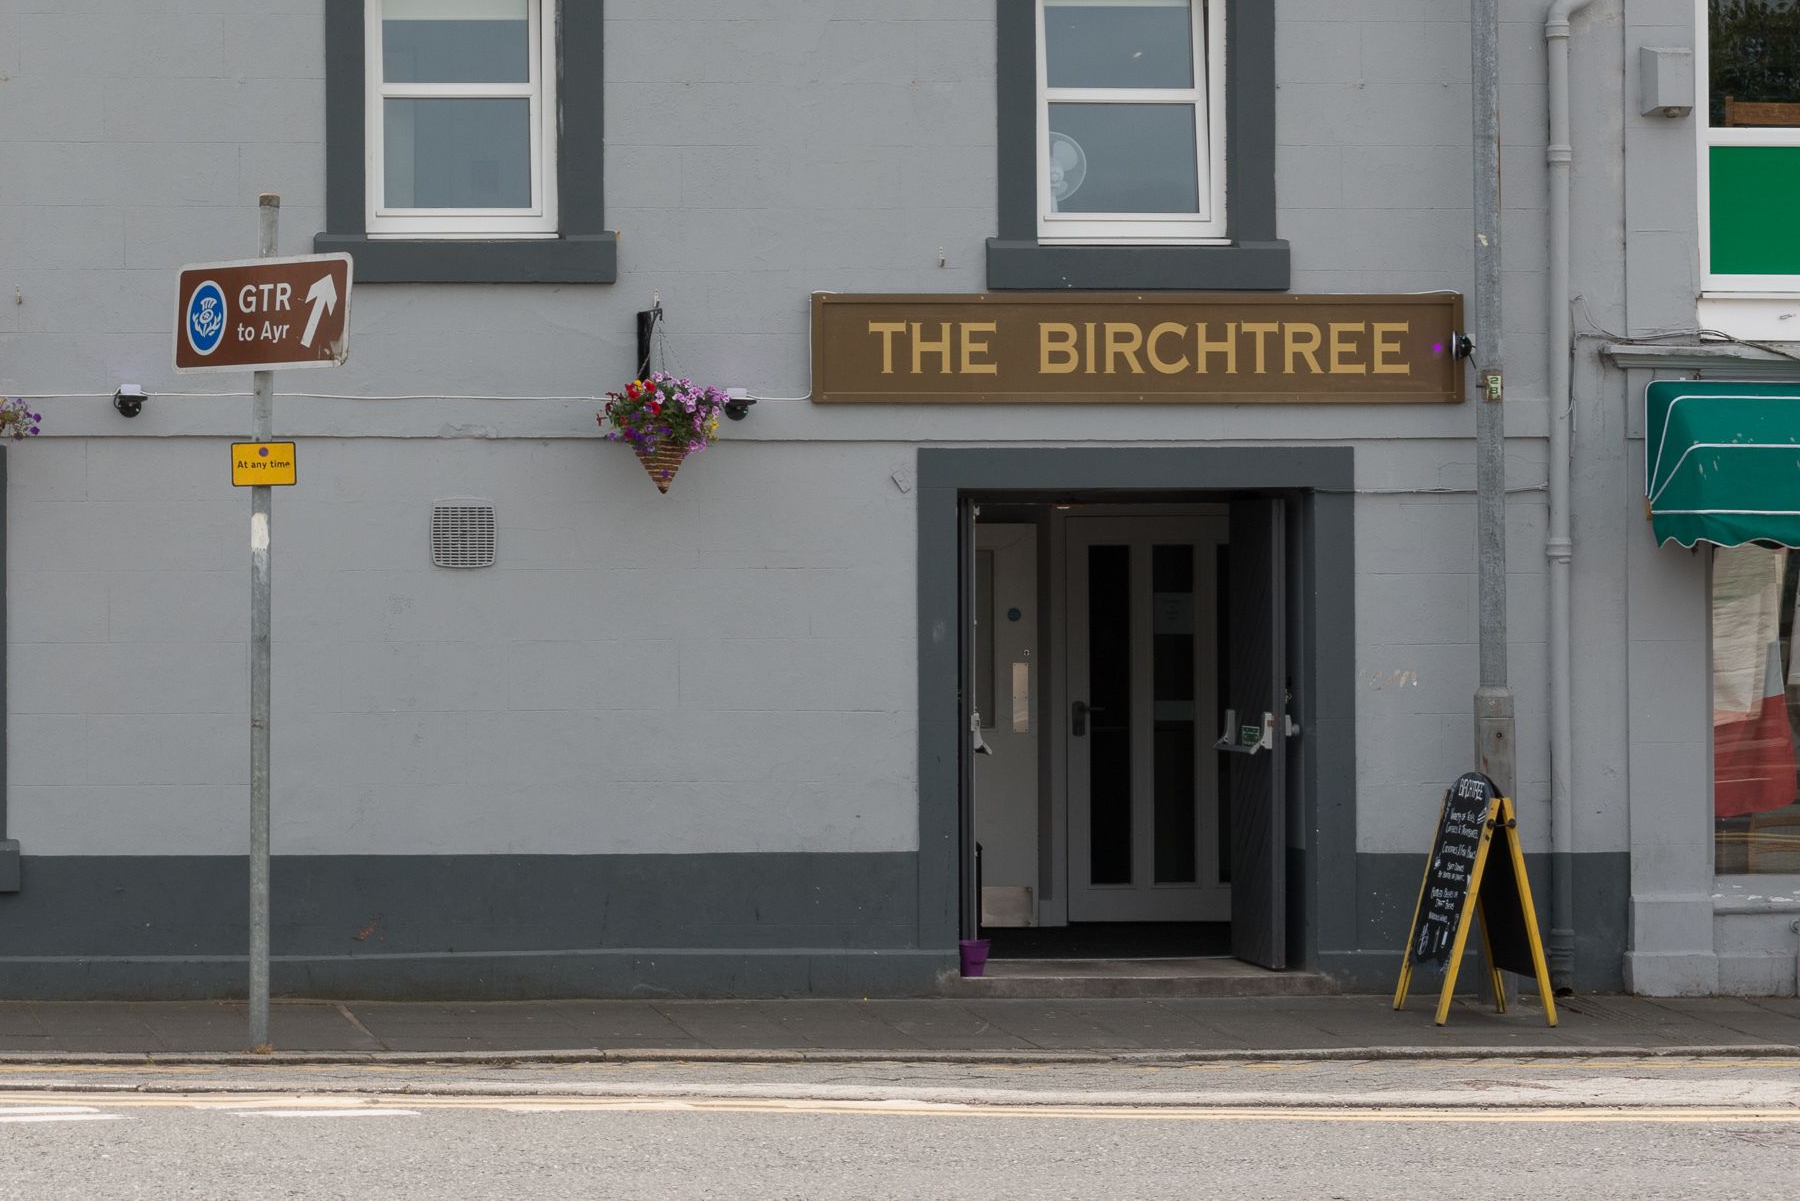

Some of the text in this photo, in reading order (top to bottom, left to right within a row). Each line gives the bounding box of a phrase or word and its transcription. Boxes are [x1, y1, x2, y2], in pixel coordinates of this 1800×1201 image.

[238, 282, 292, 313] GTR
[237, 320, 290, 343] to Ayr
[868, 319, 1411, 376] THE BIRCHTREE
[237, 460, 248, 469] At
[270, 460, 290, 468] time
